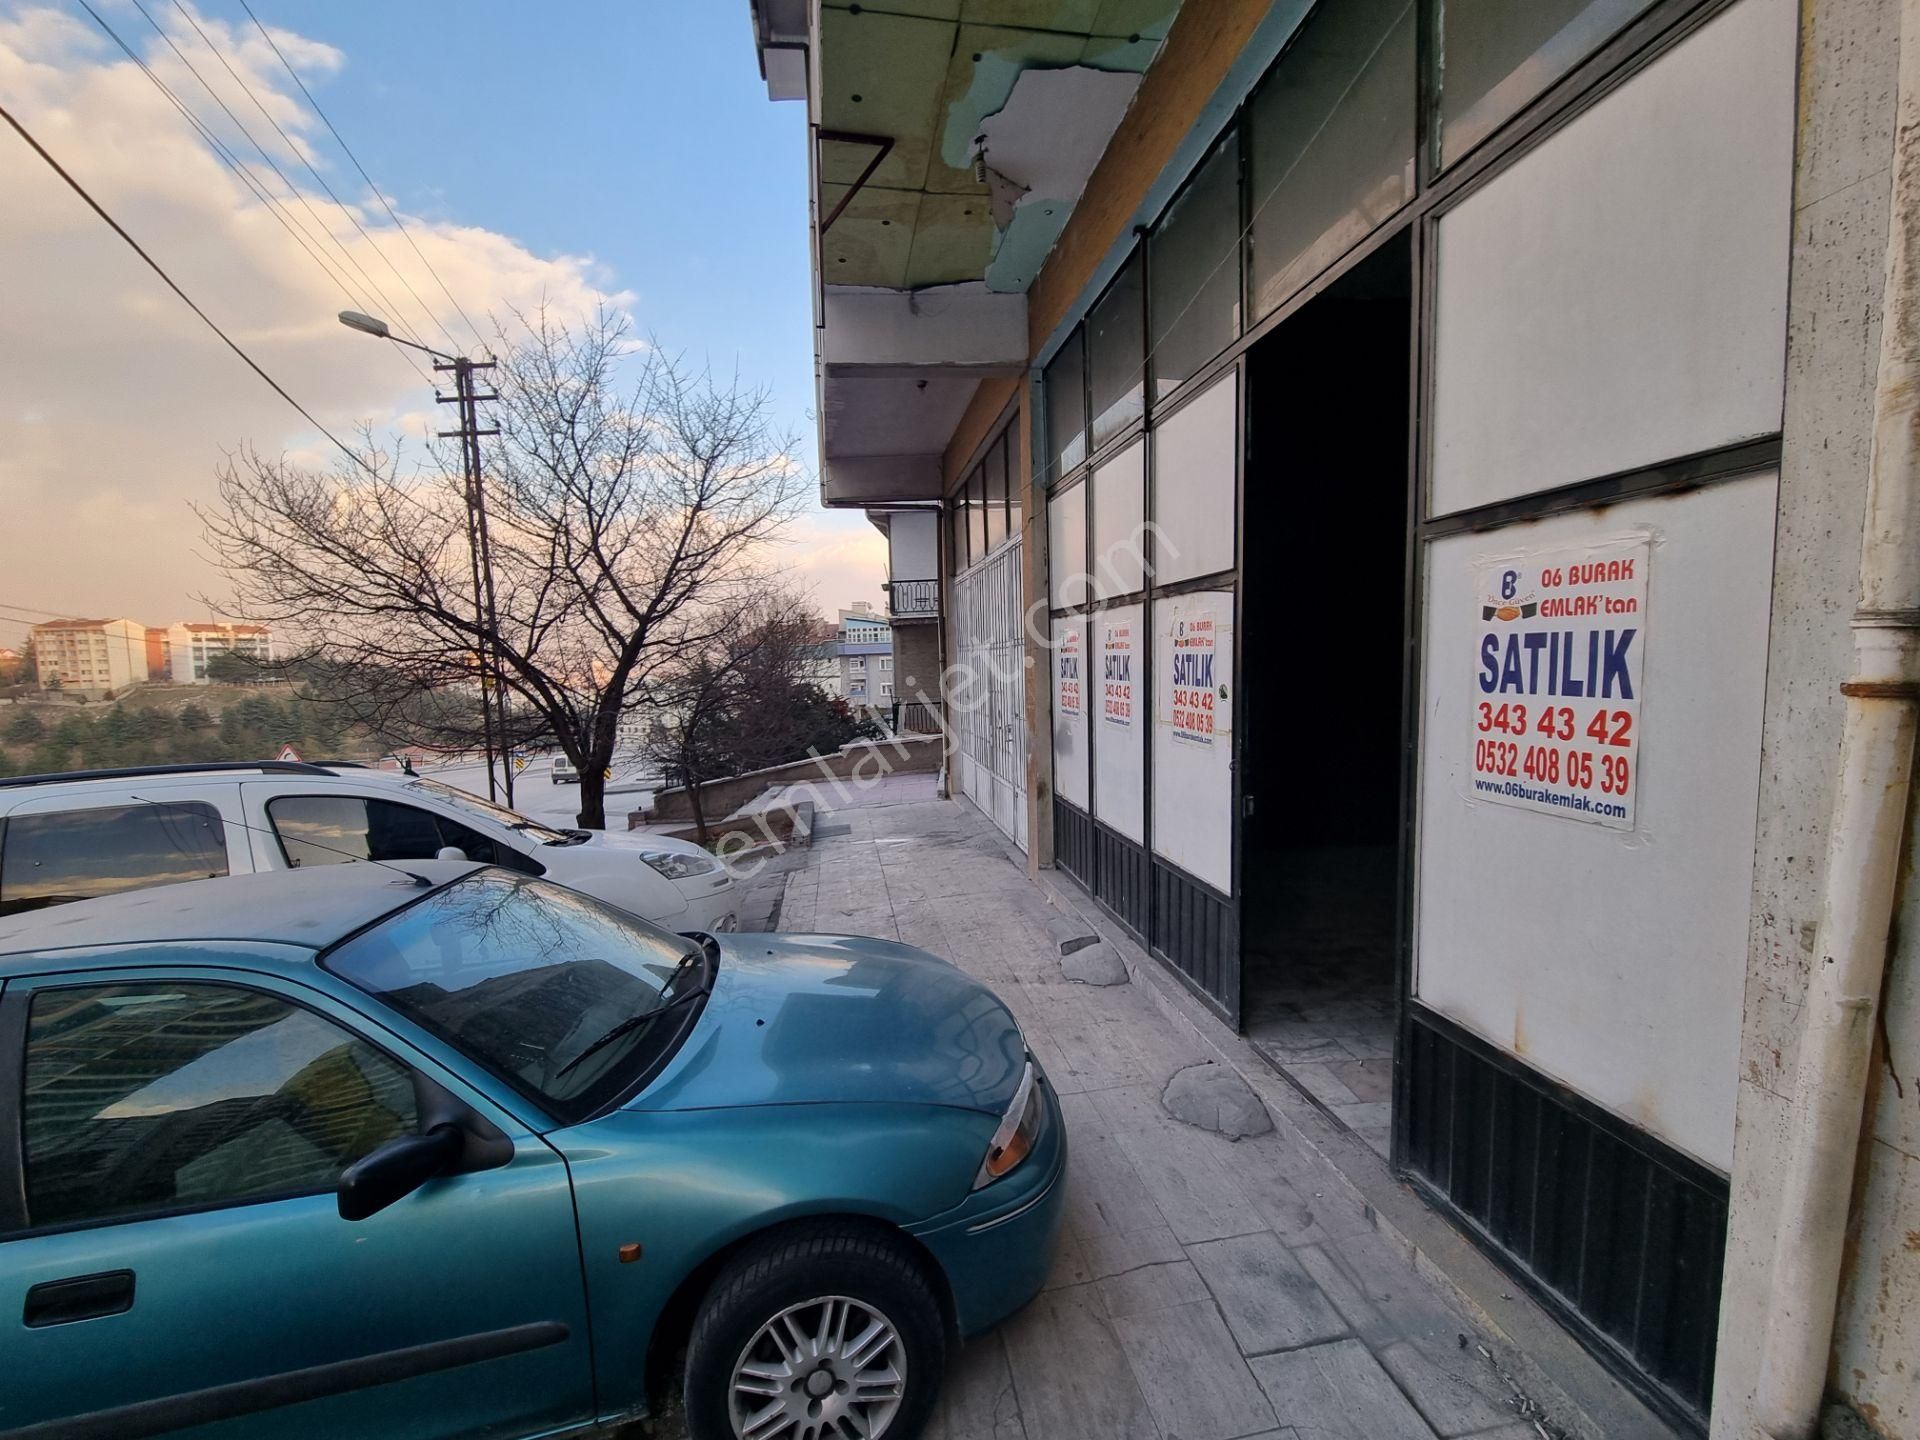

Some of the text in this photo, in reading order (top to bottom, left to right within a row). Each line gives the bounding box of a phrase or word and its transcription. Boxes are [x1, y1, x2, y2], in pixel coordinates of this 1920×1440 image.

[1541, 559, 1635, 588] 06 BURAK
[1540, 595, 1637, 618] EMLAK'tan
[1105, 654, 1130, 681] SATILIK
[1174, 653, 1213, 688] SATILIK
[1479, 629, 1637, 699] SATILIK
[1173, 689, 1213, 710] 343 43 42
[1478, 702, 1632, 747] 343 43 42
[1475, 739, 1630, 796] 0532 408 05 39
[1475, 778, 1626, 819] www.06burakemlak.com
